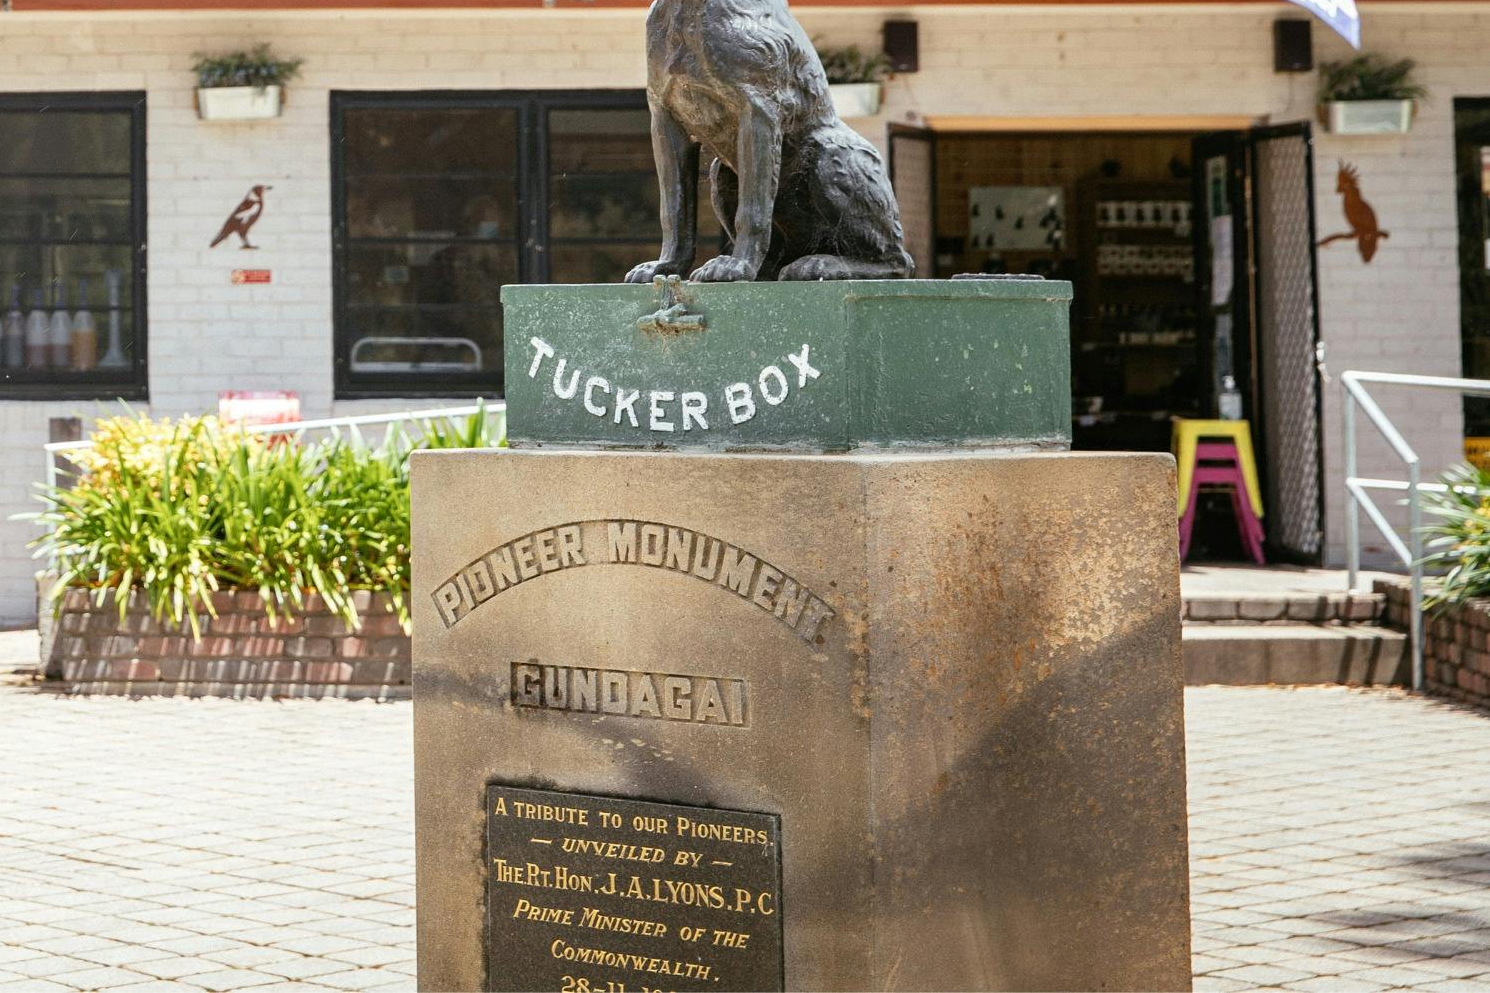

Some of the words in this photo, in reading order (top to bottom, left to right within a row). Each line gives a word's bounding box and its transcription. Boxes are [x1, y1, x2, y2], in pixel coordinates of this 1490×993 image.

[528, 336, 709, 432] TUCKER
[723, 343, 821, 425] BOX
[434, 524, 586, 627] PIONEER
[607, 521, 835, 644] MONUMENT
[514, 664, 747, 726] GUNDAGAI
[494, 796, 508, 816] A
[513, 801, 589, 826] TRIBUTE
[599, 811, 623, 829] TO
[632, 816, 669, 835] OUR
[561, 837, 666, 863] UNVEILED
[673, 851, 704, 868] BY
[512, 898, 575, 926] PRIME
[577, 906, 668, 938] MINISTER
[679, 926, 707, 943] OF
[713, 929, 751, 949] THE
